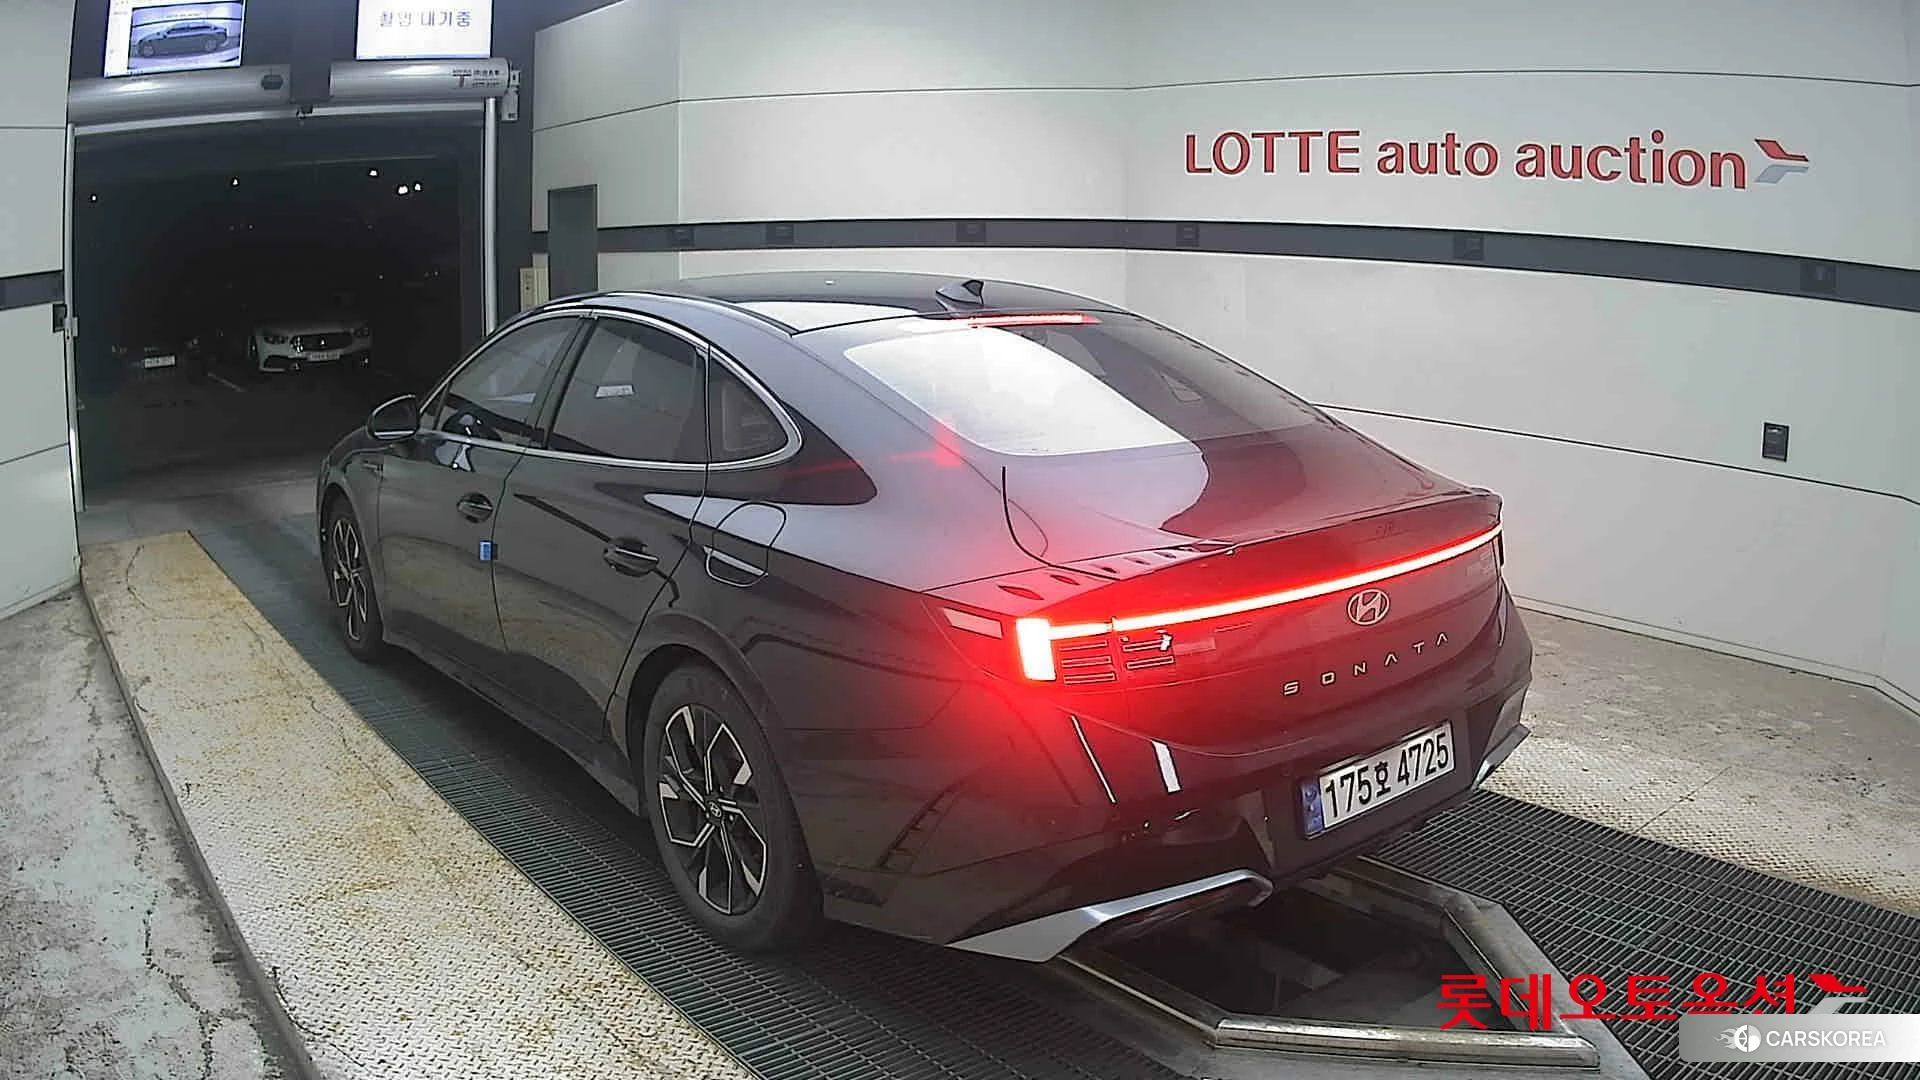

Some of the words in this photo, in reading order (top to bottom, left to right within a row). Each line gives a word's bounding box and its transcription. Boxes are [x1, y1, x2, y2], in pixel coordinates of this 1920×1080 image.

[1185, 131, 1361, 174] LOTTE
[1376, 132, 1499, 178] auto
[1515, 130, 1747, 189] auction
[1283, 632, 1449, 696] SONATA
[1397, 732, 1449, 786] 4725
